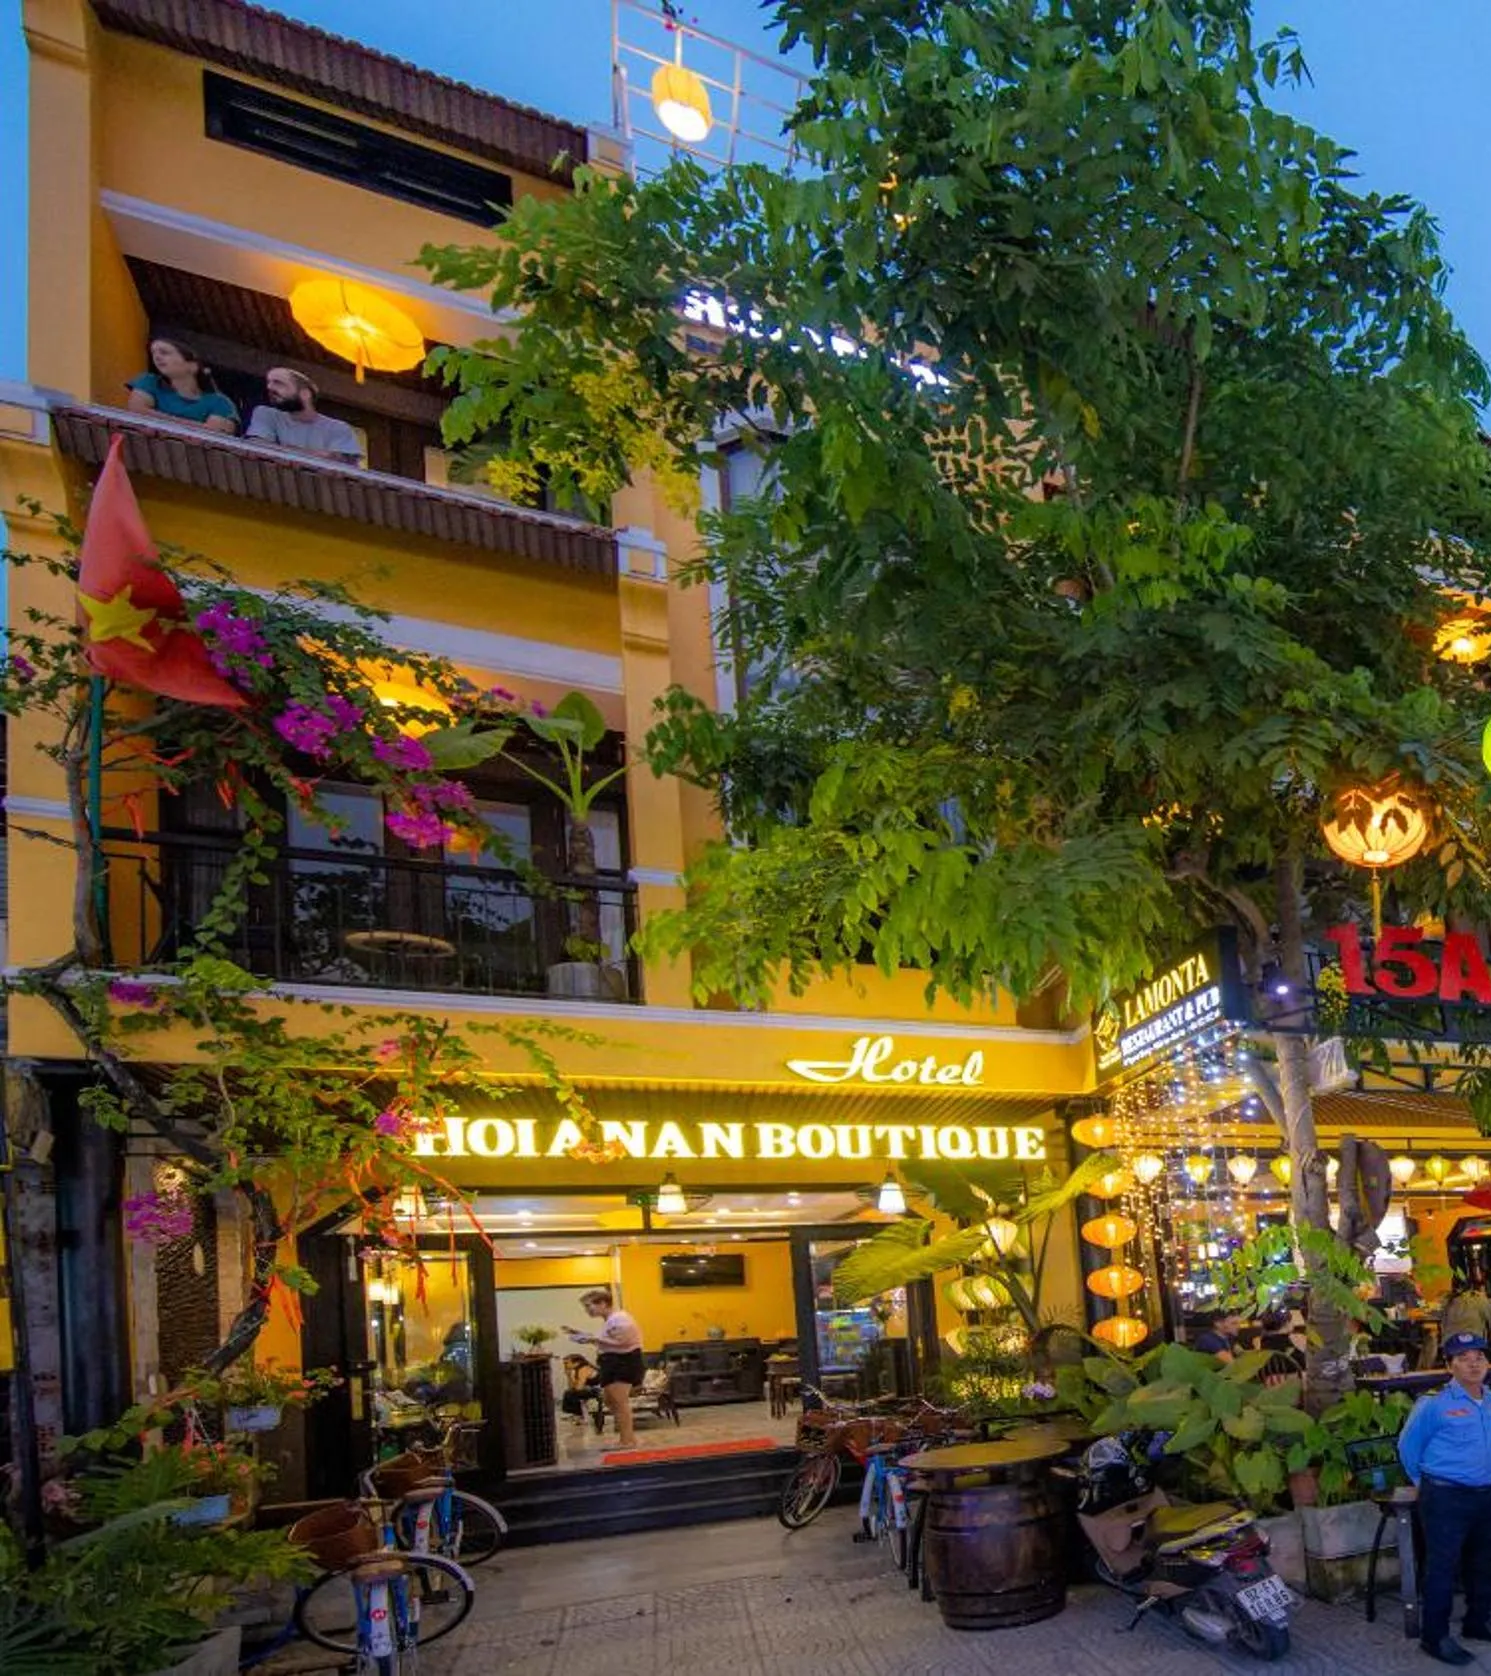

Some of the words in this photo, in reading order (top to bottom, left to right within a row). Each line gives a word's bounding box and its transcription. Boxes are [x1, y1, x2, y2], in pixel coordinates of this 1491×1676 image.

[1124, 953, 1210, 1029] LAMONTA
[785, 1035, 984, 1086] Hotel
[753, 1122, 1046, 1160] BOUTIQUE
